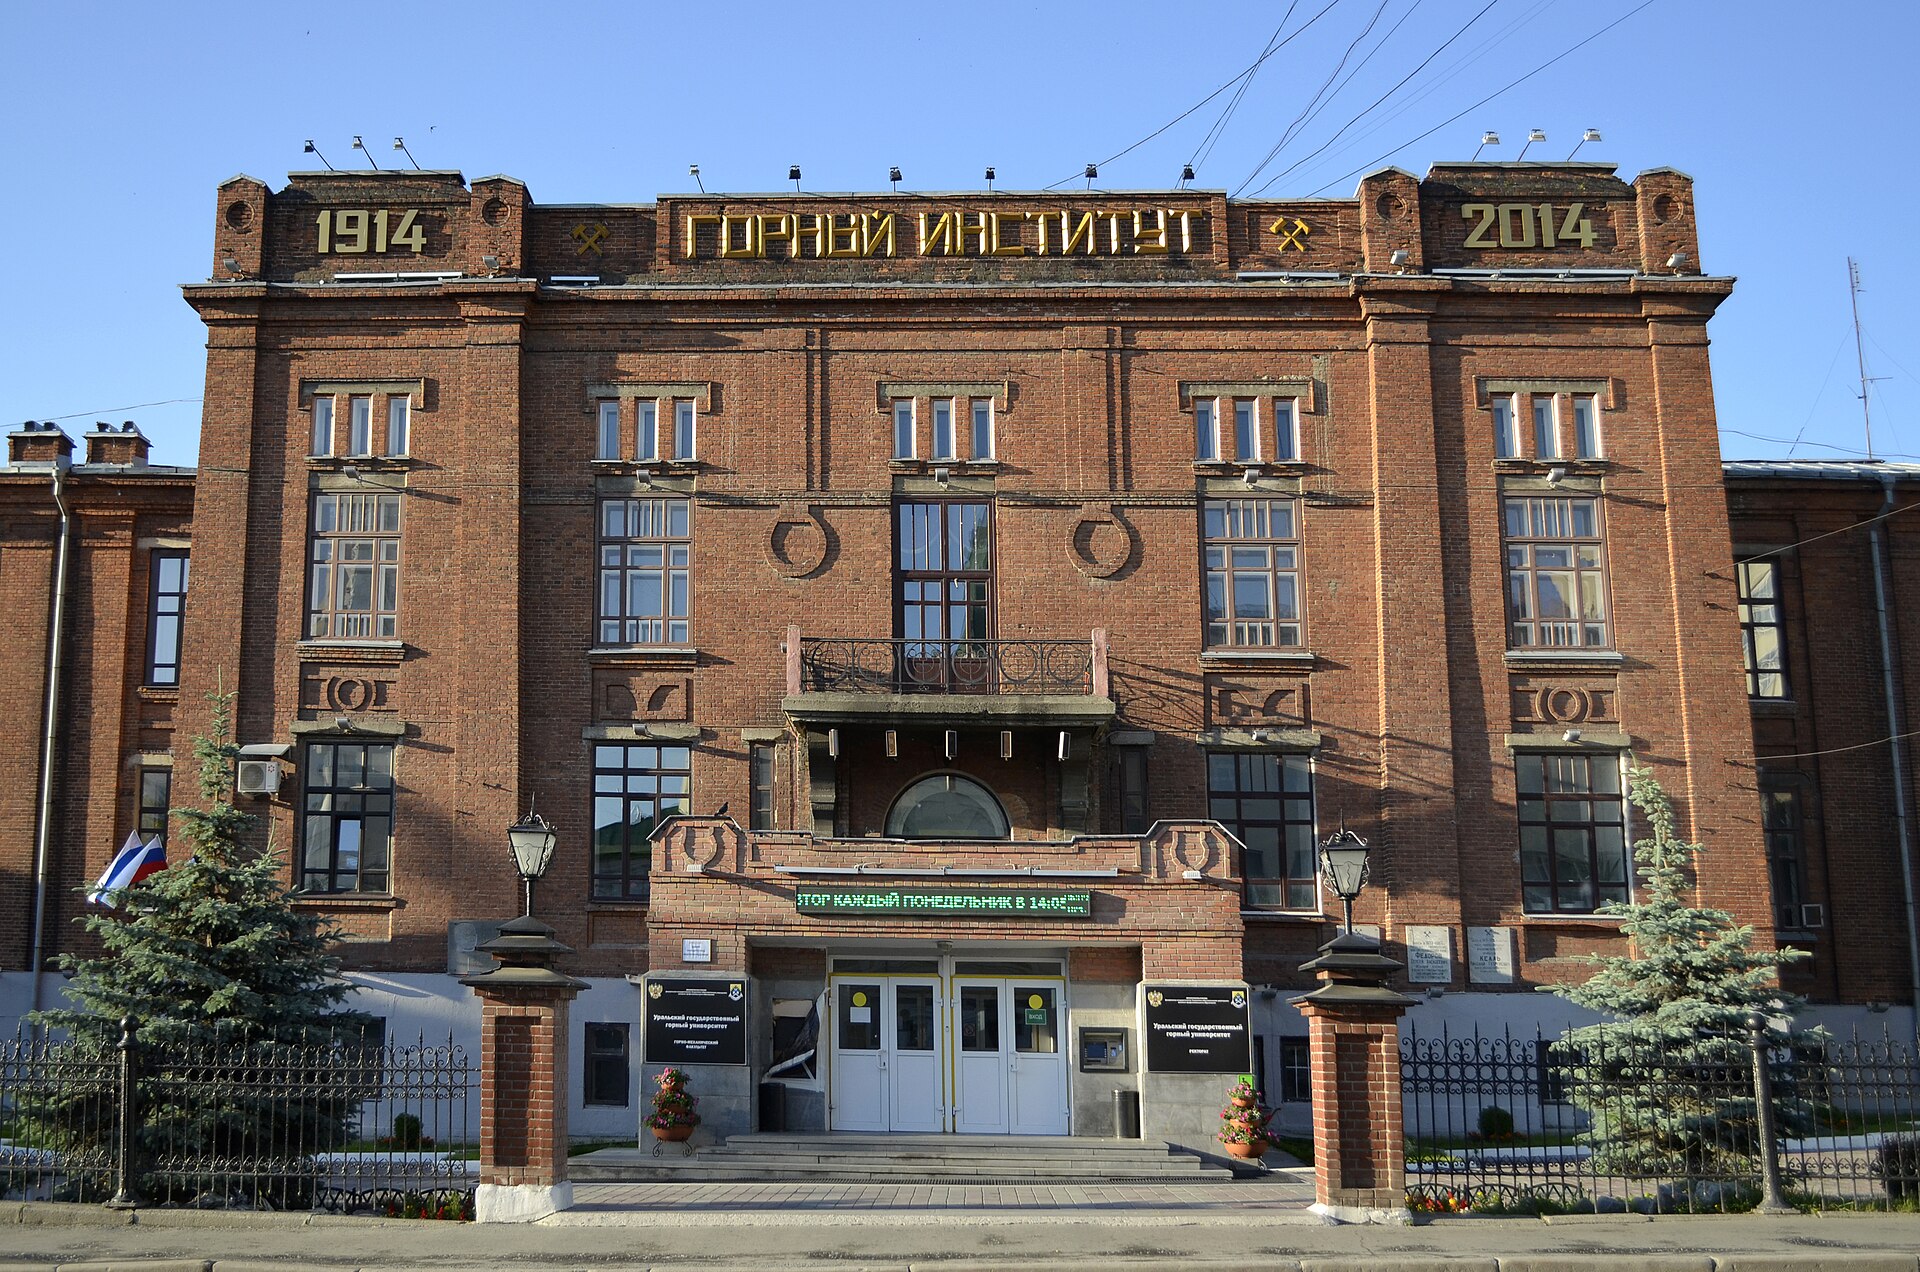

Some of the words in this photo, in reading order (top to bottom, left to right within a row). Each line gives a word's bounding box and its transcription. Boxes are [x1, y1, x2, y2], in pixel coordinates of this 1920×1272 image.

[316, 209, 427, 253] 1914
[687, 210, 896, 259] ГОРНЫЙ
[919, 209, 1203, 256] ИНСТИТУТ
[1461, 203, 1598, 248] 2014
[833, 892, 899, 907] КАЖДЫЙ
[903, 895, 1013, 909] ПОНЕДЕЛЬНИК
[1016, 896, 1026, 909] В
[1190, 1031, 1231, 1039] университет
